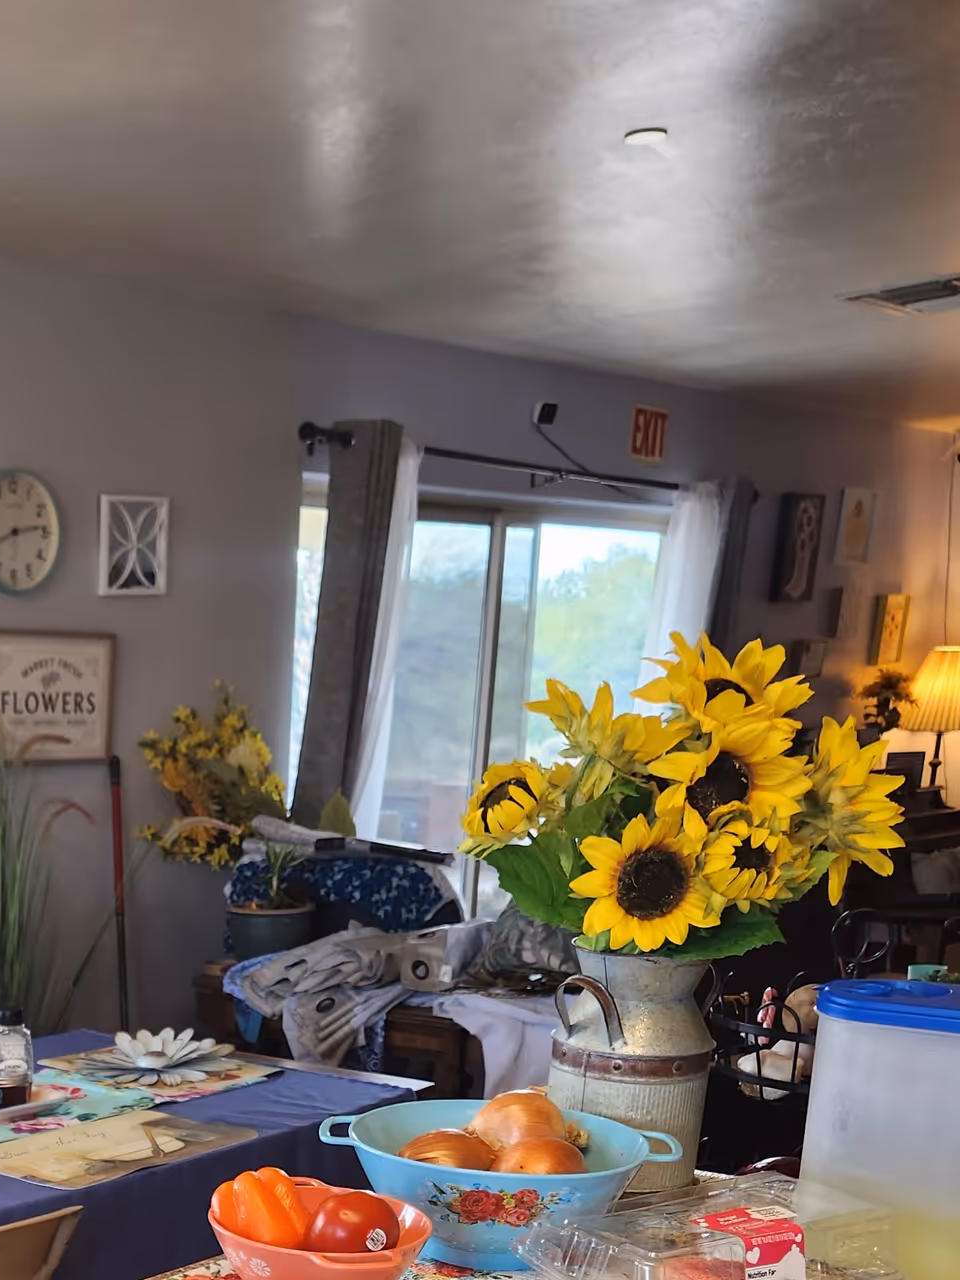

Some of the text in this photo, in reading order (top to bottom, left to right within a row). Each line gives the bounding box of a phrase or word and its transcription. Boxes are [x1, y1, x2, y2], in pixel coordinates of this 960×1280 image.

[631, 408, 668, 458] EXIT
[0, 691, 96, 715] FLOWERS
[747, 1270, 768, 1280] Nutrition
